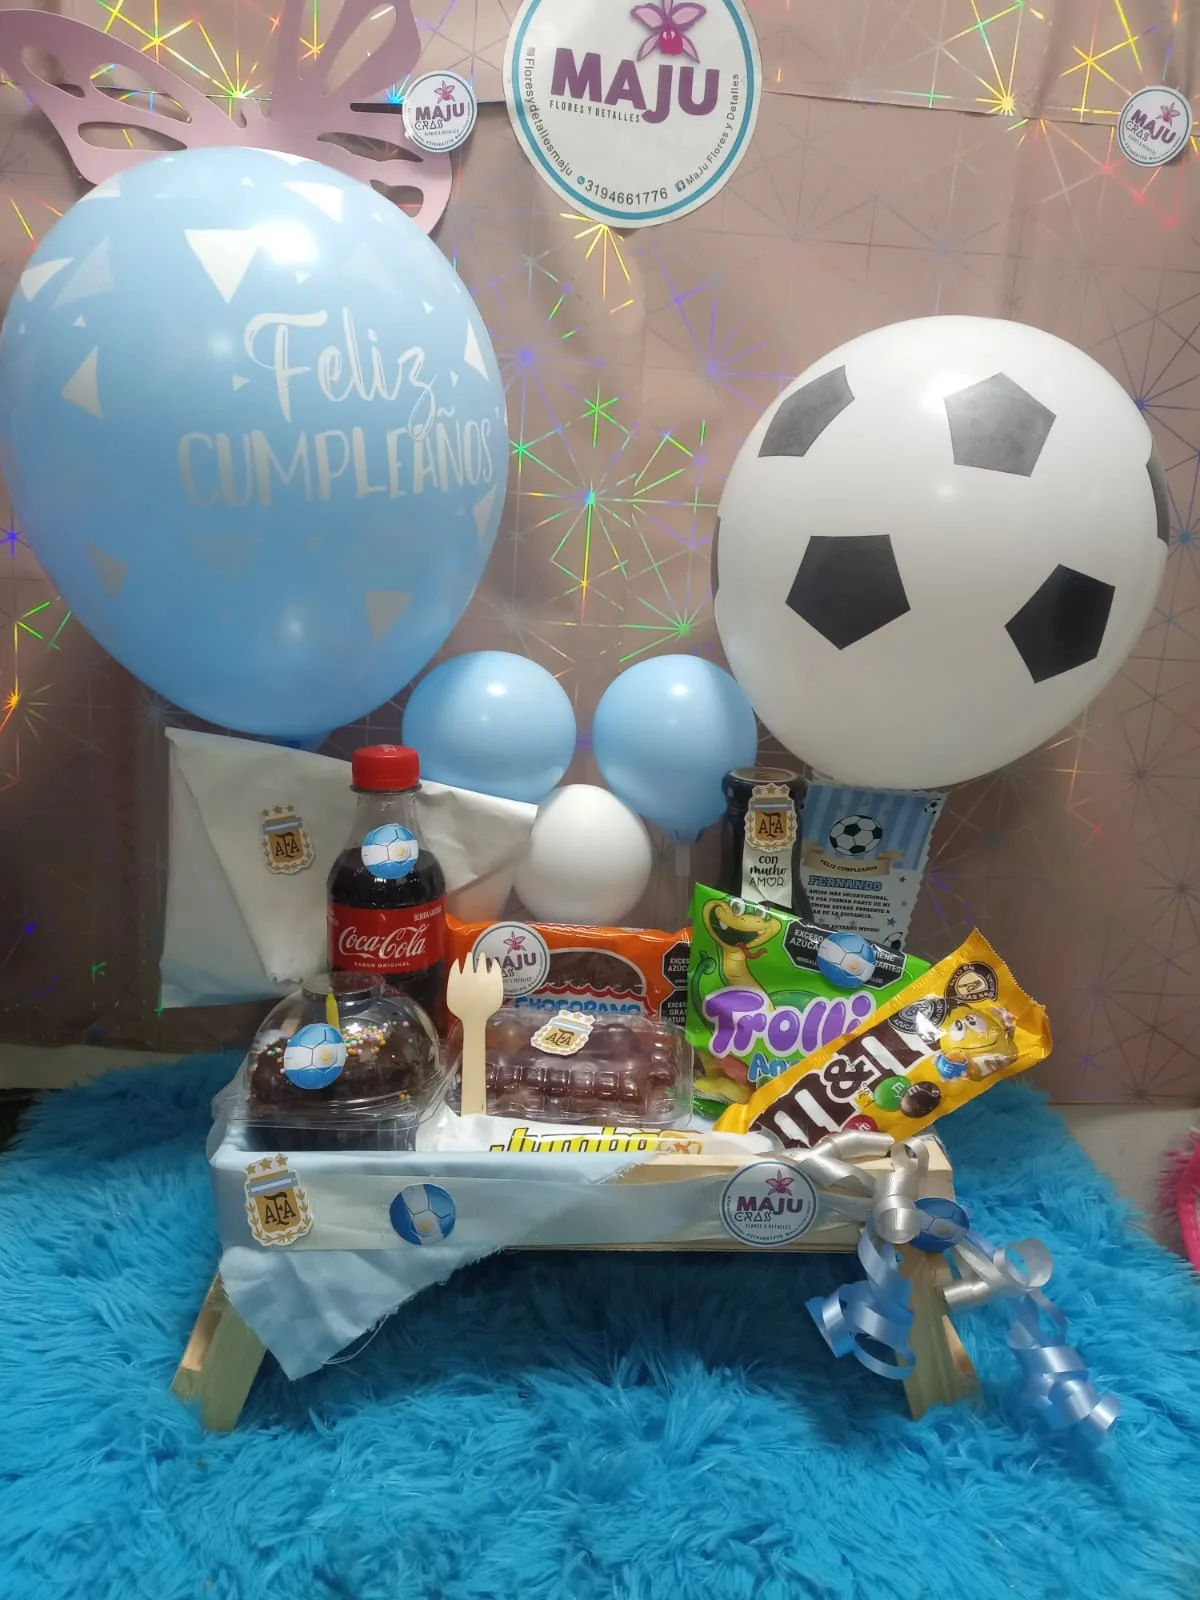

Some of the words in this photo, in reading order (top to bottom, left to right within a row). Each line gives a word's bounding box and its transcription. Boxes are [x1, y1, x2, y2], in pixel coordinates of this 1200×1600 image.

[550, 47, 720, 124] MAJU
[726, 73, 740, 121] Detalles
[415, 102, 465, 122] MAJU
[524, 57, 574, 178] Floresydetallesmaju
[549, 99, 585, 115] FLORES
[587, 106, 593, 117] Y
[595, 107, 641, 124] DETALLES
[725, 122, 734, 131] y
[1130, 108, 1177, 144] MAJU
[706, 131, 730, 164] Flores
[585, 180, 669, 206] 3194661776
[243, 306, 440, 443] Feliz
[178, 405, 494, 509] CUMPLEAÑOS
[757, 812, 785, 838] AFA
[274, 831, 301, 859] AFA
[749, 864, 788, 876] mucho
[758, 855, 779, 864] con
[807, 875, 883, 892] FERNANDO
[338, 923, 430, 960] Coca-Cola
[794, 929, 824, 943] EXCESO
[354, 961, 376, 969] SABOR
[377, 961, 411, 969] ORIGINAL
[705, 993, 874, 1055] Trolli
[546, 1028, 575, 1047] AFA
[489, 1126, 660, 1152] Jumbo
[264, 1191, 297, 1226] AFA
[735, 1196, 804, 1216] MAJU
